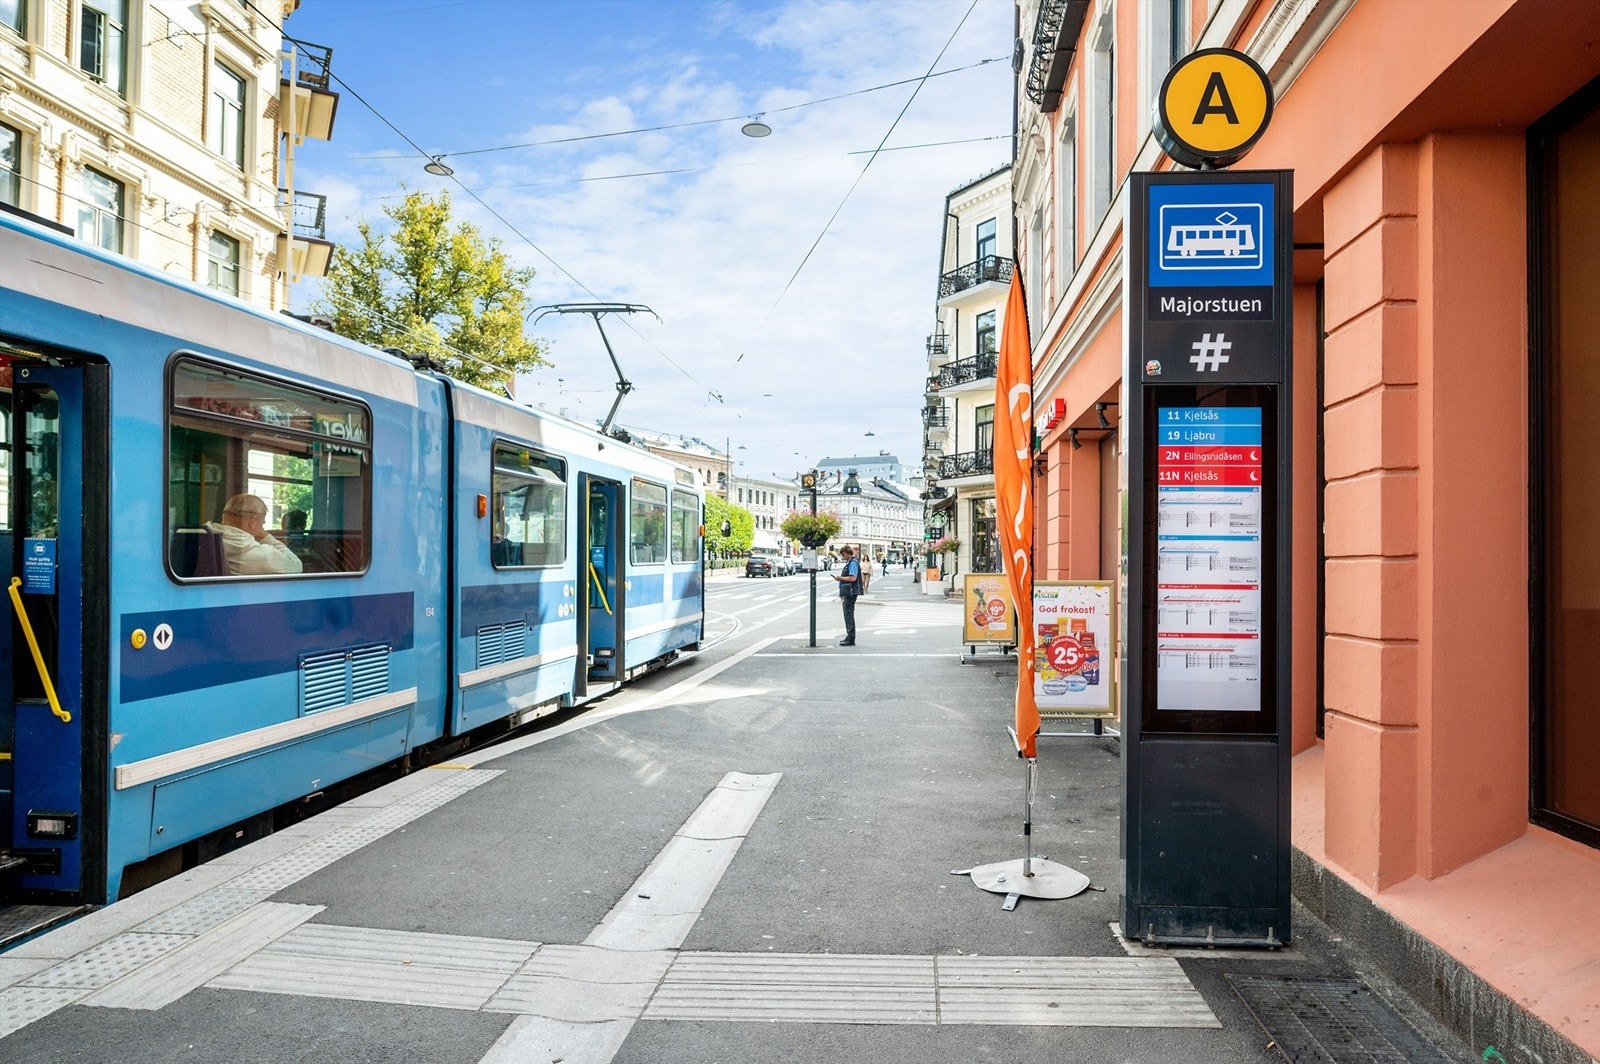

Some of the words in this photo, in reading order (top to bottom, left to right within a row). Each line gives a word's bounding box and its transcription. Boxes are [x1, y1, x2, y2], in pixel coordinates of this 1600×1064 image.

[1191, 71, 1240, 125] A
[1160, 296, 1262, 316] Majorstuen
[1167, 411, 1180, 420] 11
[1184, 410, 1219, 422] Kjelsås
[1167, 431, 1181, 440] 19
[1184, 431, 1216, 442] Ljabru
[1165, 451, 1180, 460] 2N
[1184, 451, 1243, 462] Ellingsrudåsen
[1159, 471, 1180, 481] 11N
[1184, 470, 1219, 482] Kjelsås
[1038, 605, 1058, 613] God
[1060, 605, 1096, 614] frokost!
[1054, 646, 1078, 665] 25
